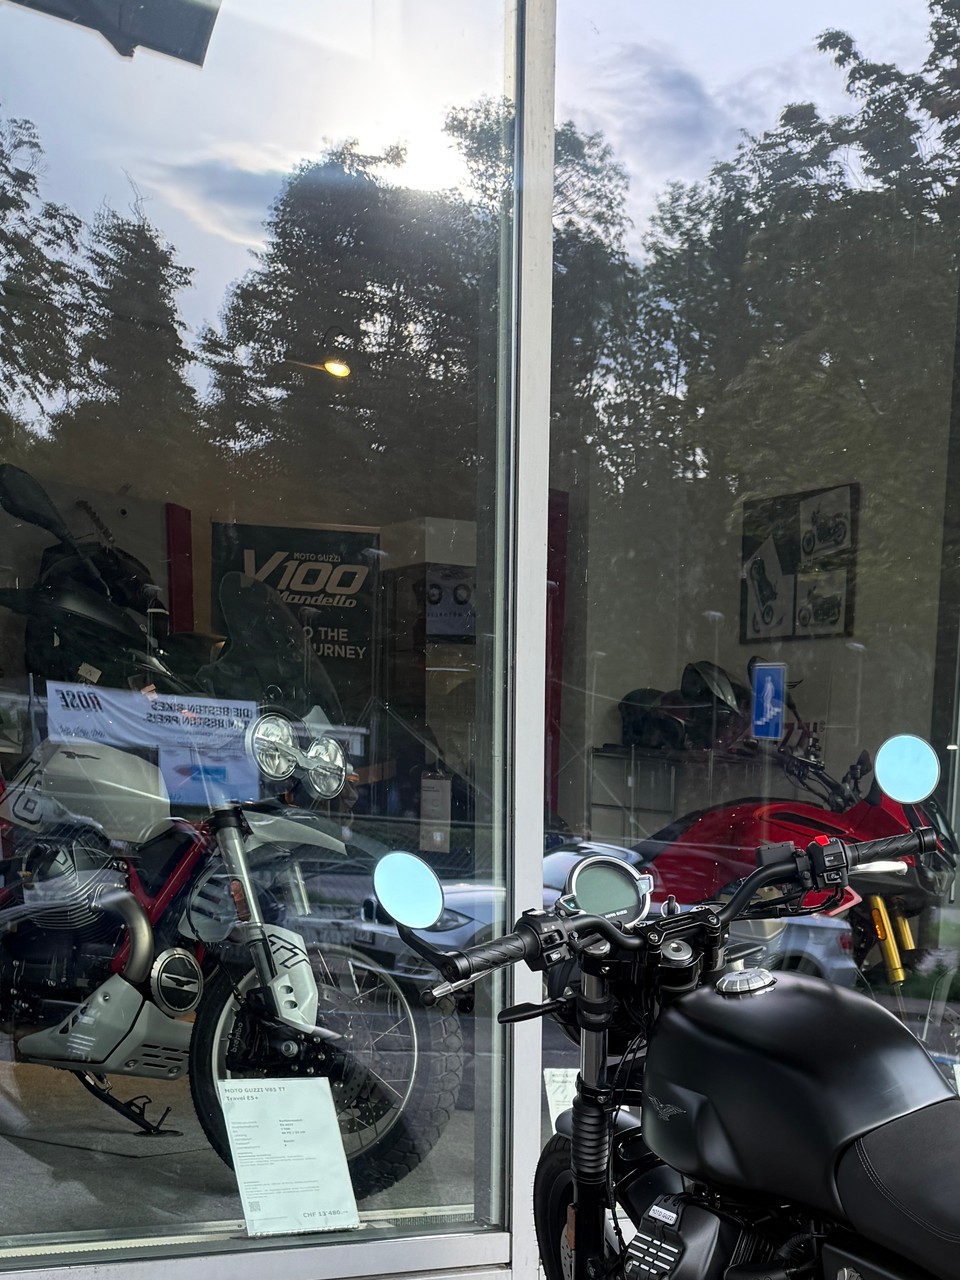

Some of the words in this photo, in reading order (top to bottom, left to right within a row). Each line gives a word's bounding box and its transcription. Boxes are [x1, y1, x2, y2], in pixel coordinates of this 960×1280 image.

[293, 552, 316, 561] MOTO
[317, 553, 341, 563] GUZZI
[241, 549, 369, 595] V100
[318, 627, 348, 641] THE
[312, 645, 367, 659] URNEY
[230, 1022, 244, 1053] brembo
